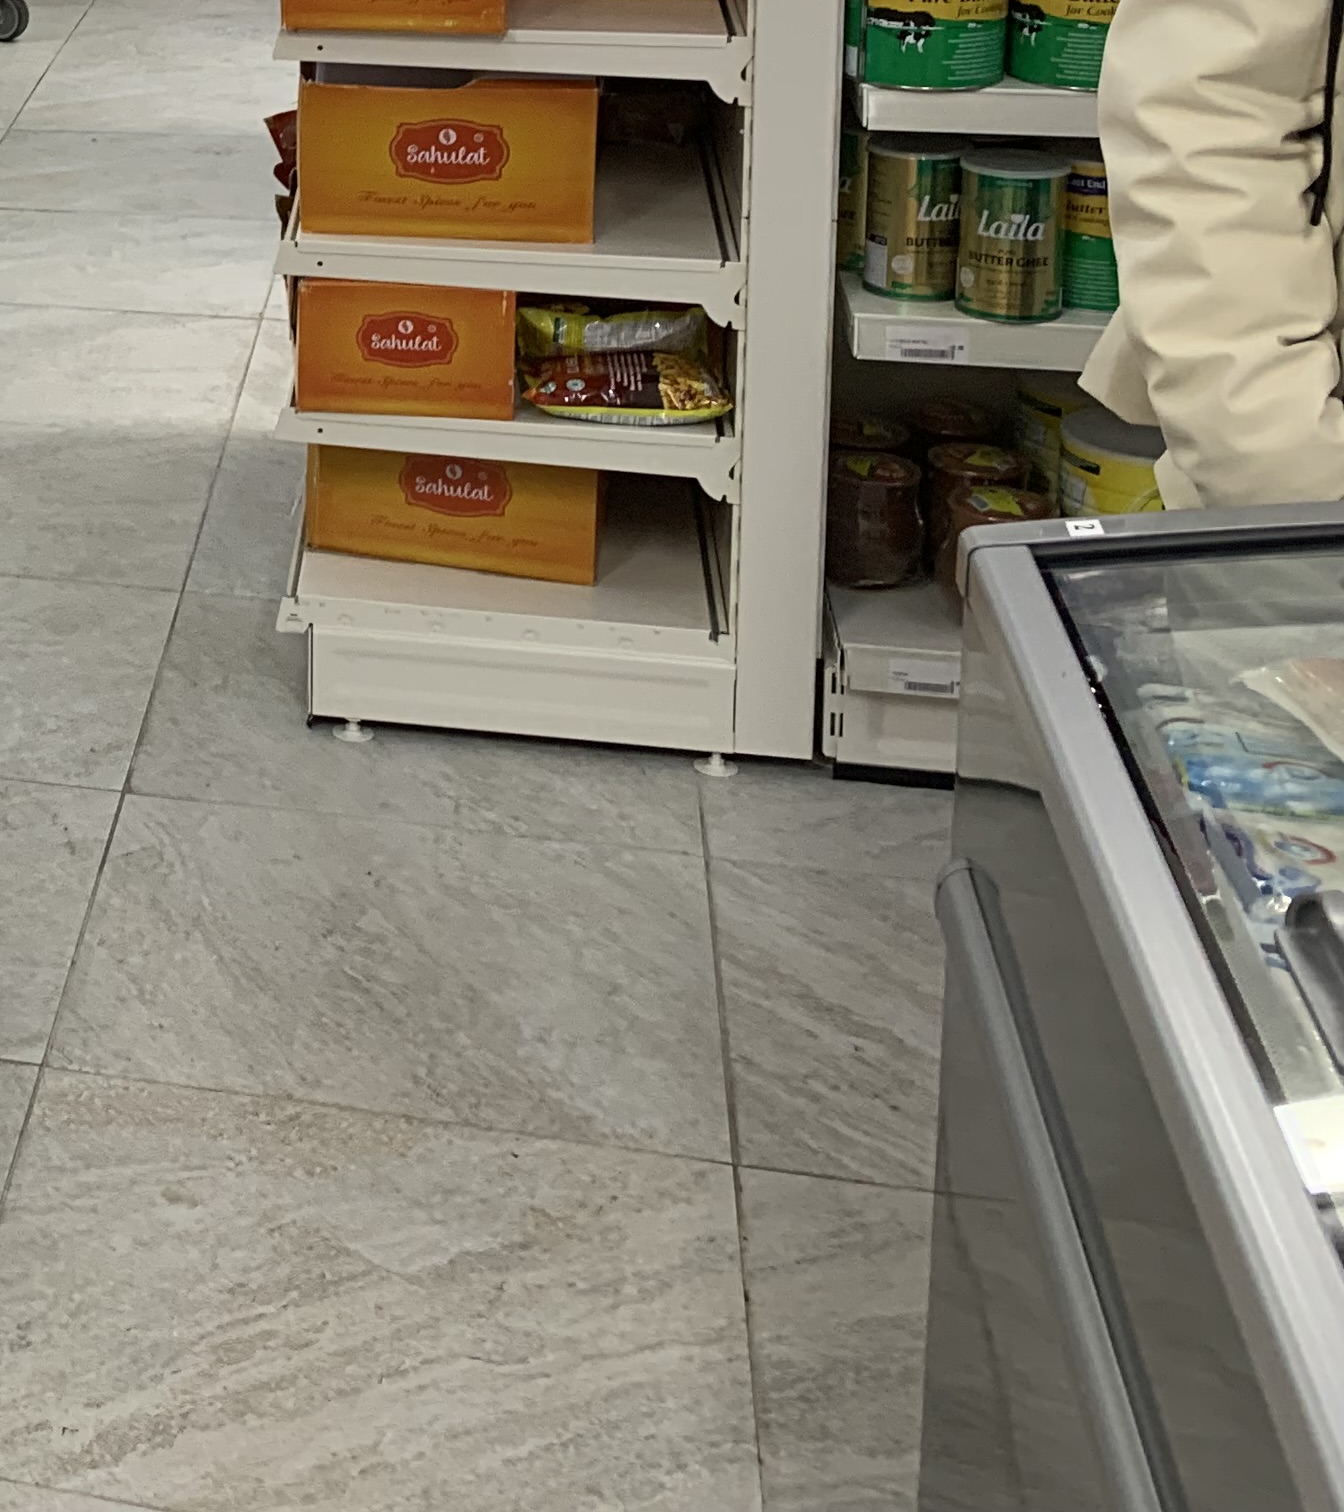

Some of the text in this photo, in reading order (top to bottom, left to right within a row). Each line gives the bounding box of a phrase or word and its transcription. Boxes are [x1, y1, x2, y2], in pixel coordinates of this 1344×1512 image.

[406, 142, 491, 166] Sahulat
[978, 208, 1046, 242] Laila
[968, 252, 1014, 267] BUTTER
[370, 327, 443, 353] Sahulat
[414, 474, 495, 502] Sahulat
[1075, 521, 1096, 533] 2
